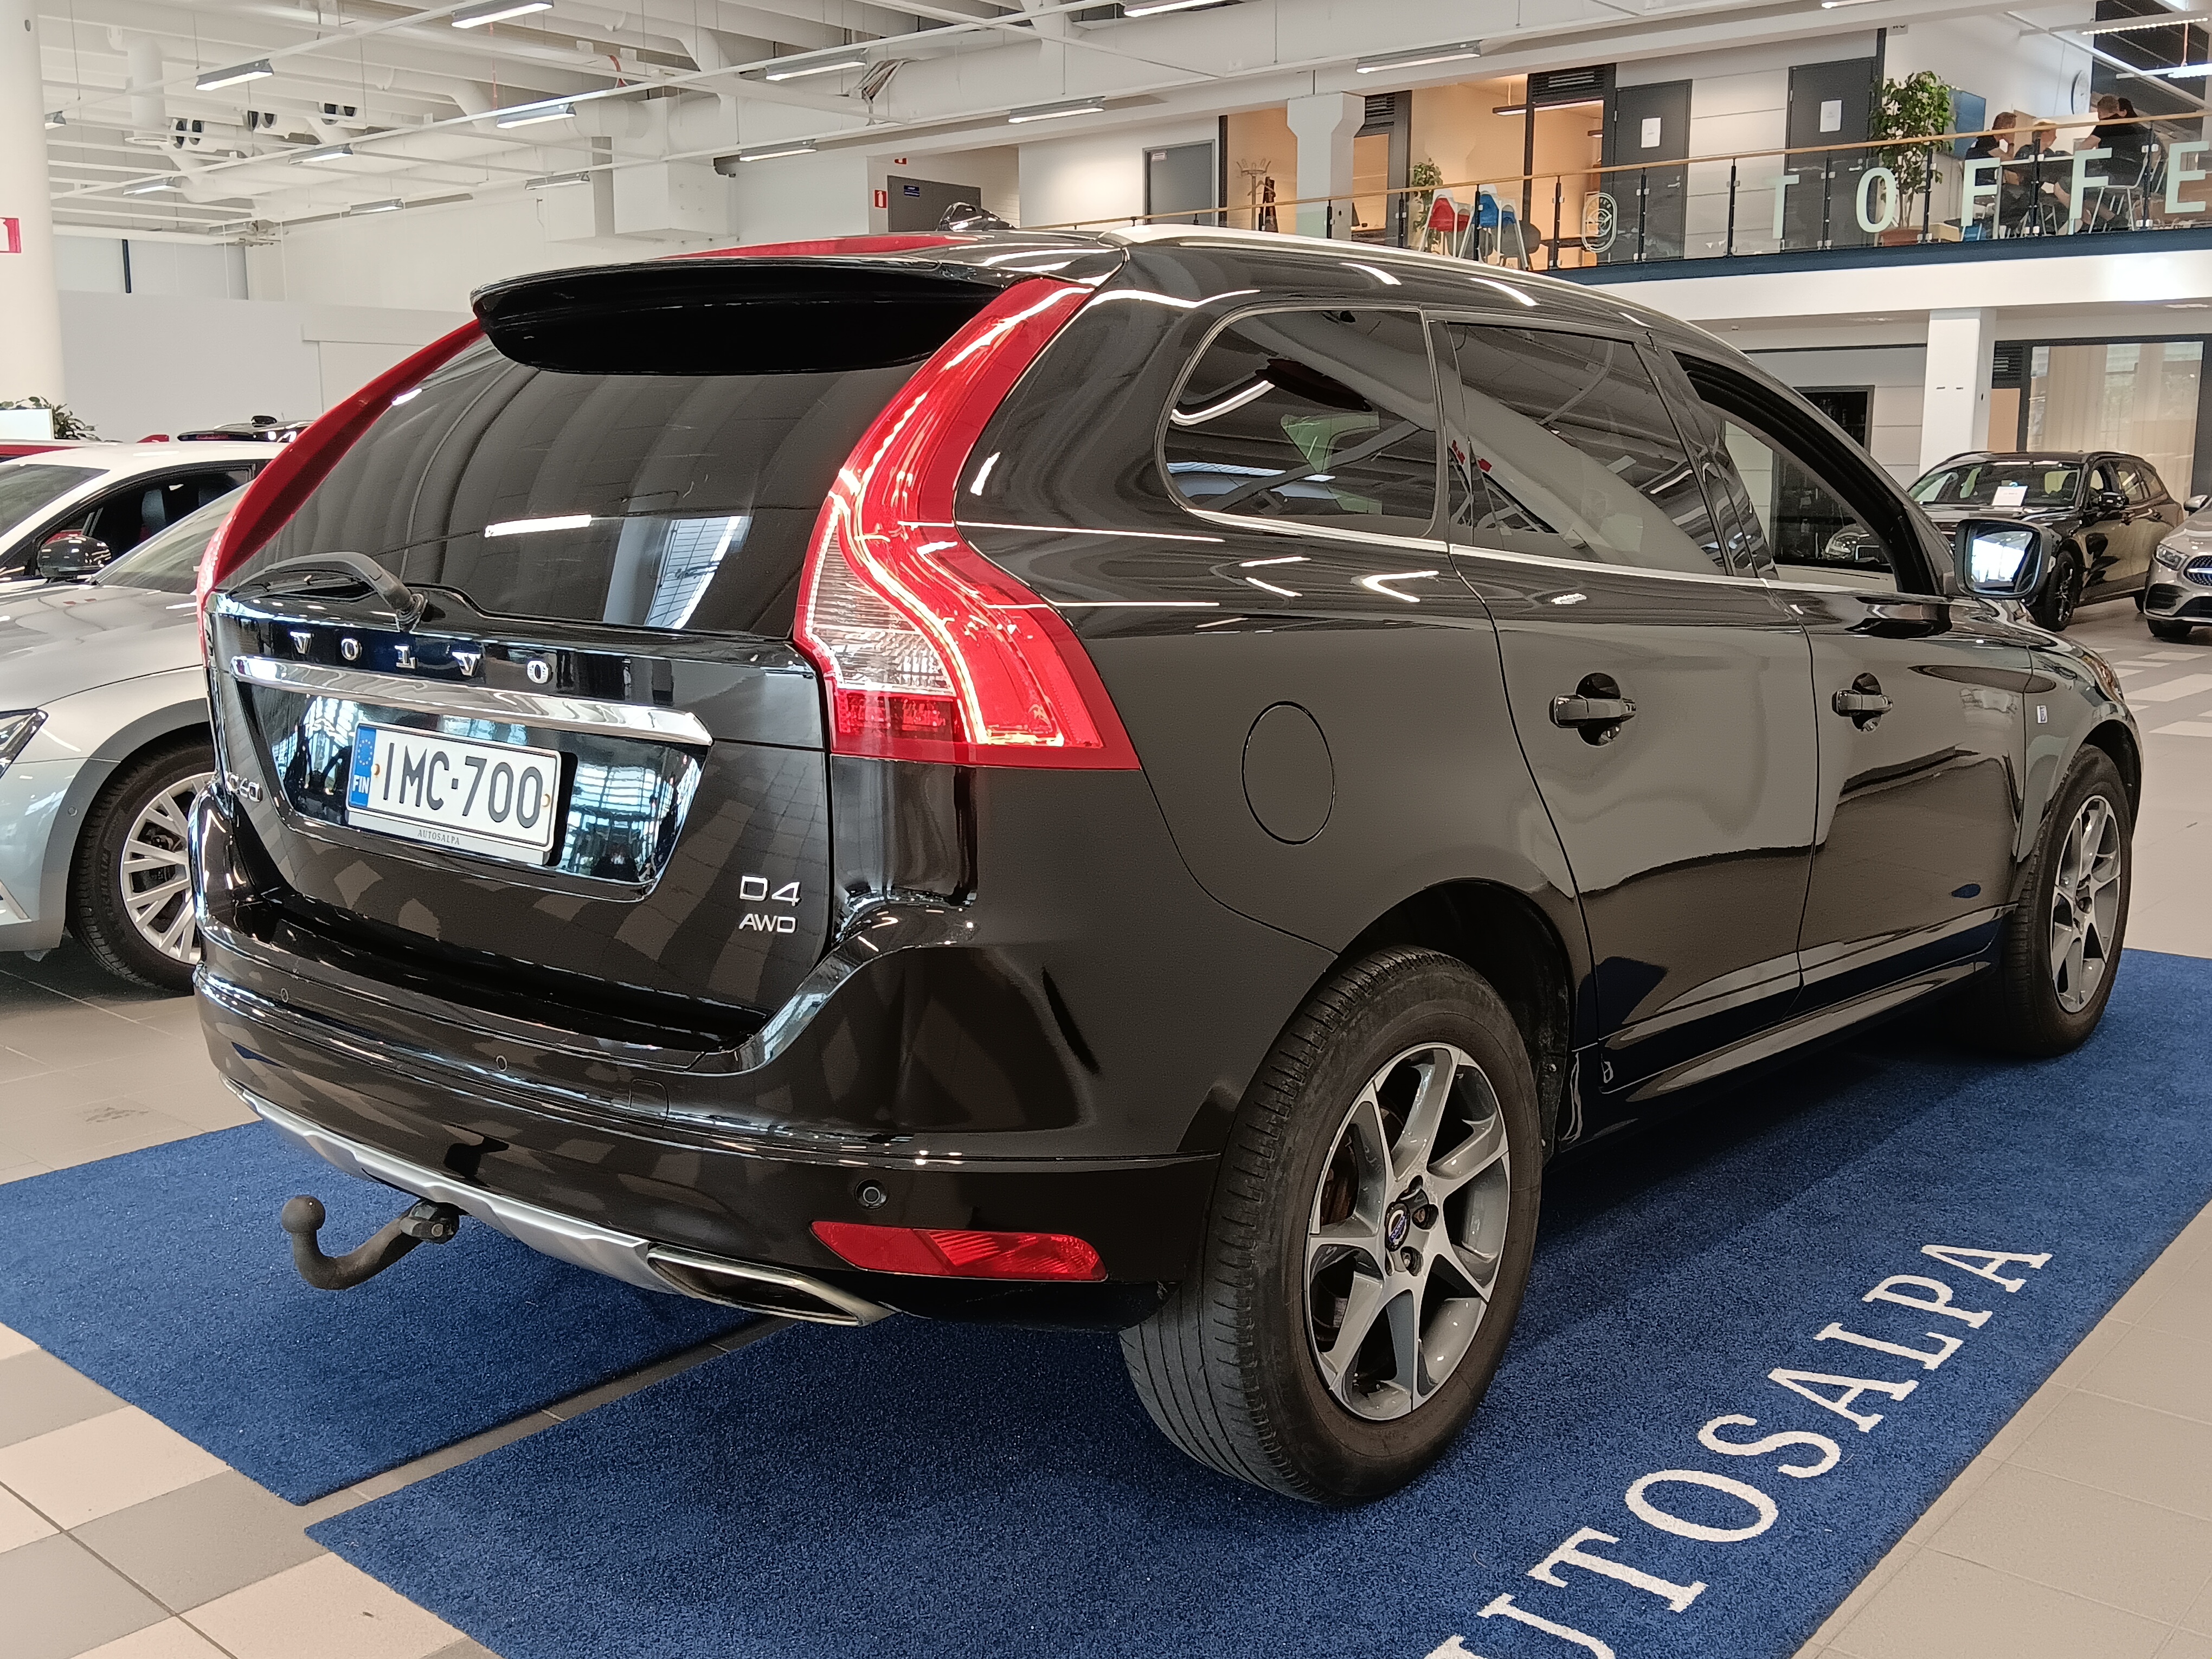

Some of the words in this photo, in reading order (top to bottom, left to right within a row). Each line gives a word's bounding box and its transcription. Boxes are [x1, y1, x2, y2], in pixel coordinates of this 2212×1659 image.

[290, 631, 552, 684] VOLVO
[352, 775, 370, 794] FIN
[417, 829, 460, 845] AUTOSALPA
[740, 876, 801, 906] D4
[738, 914, 796, 933] AWD
